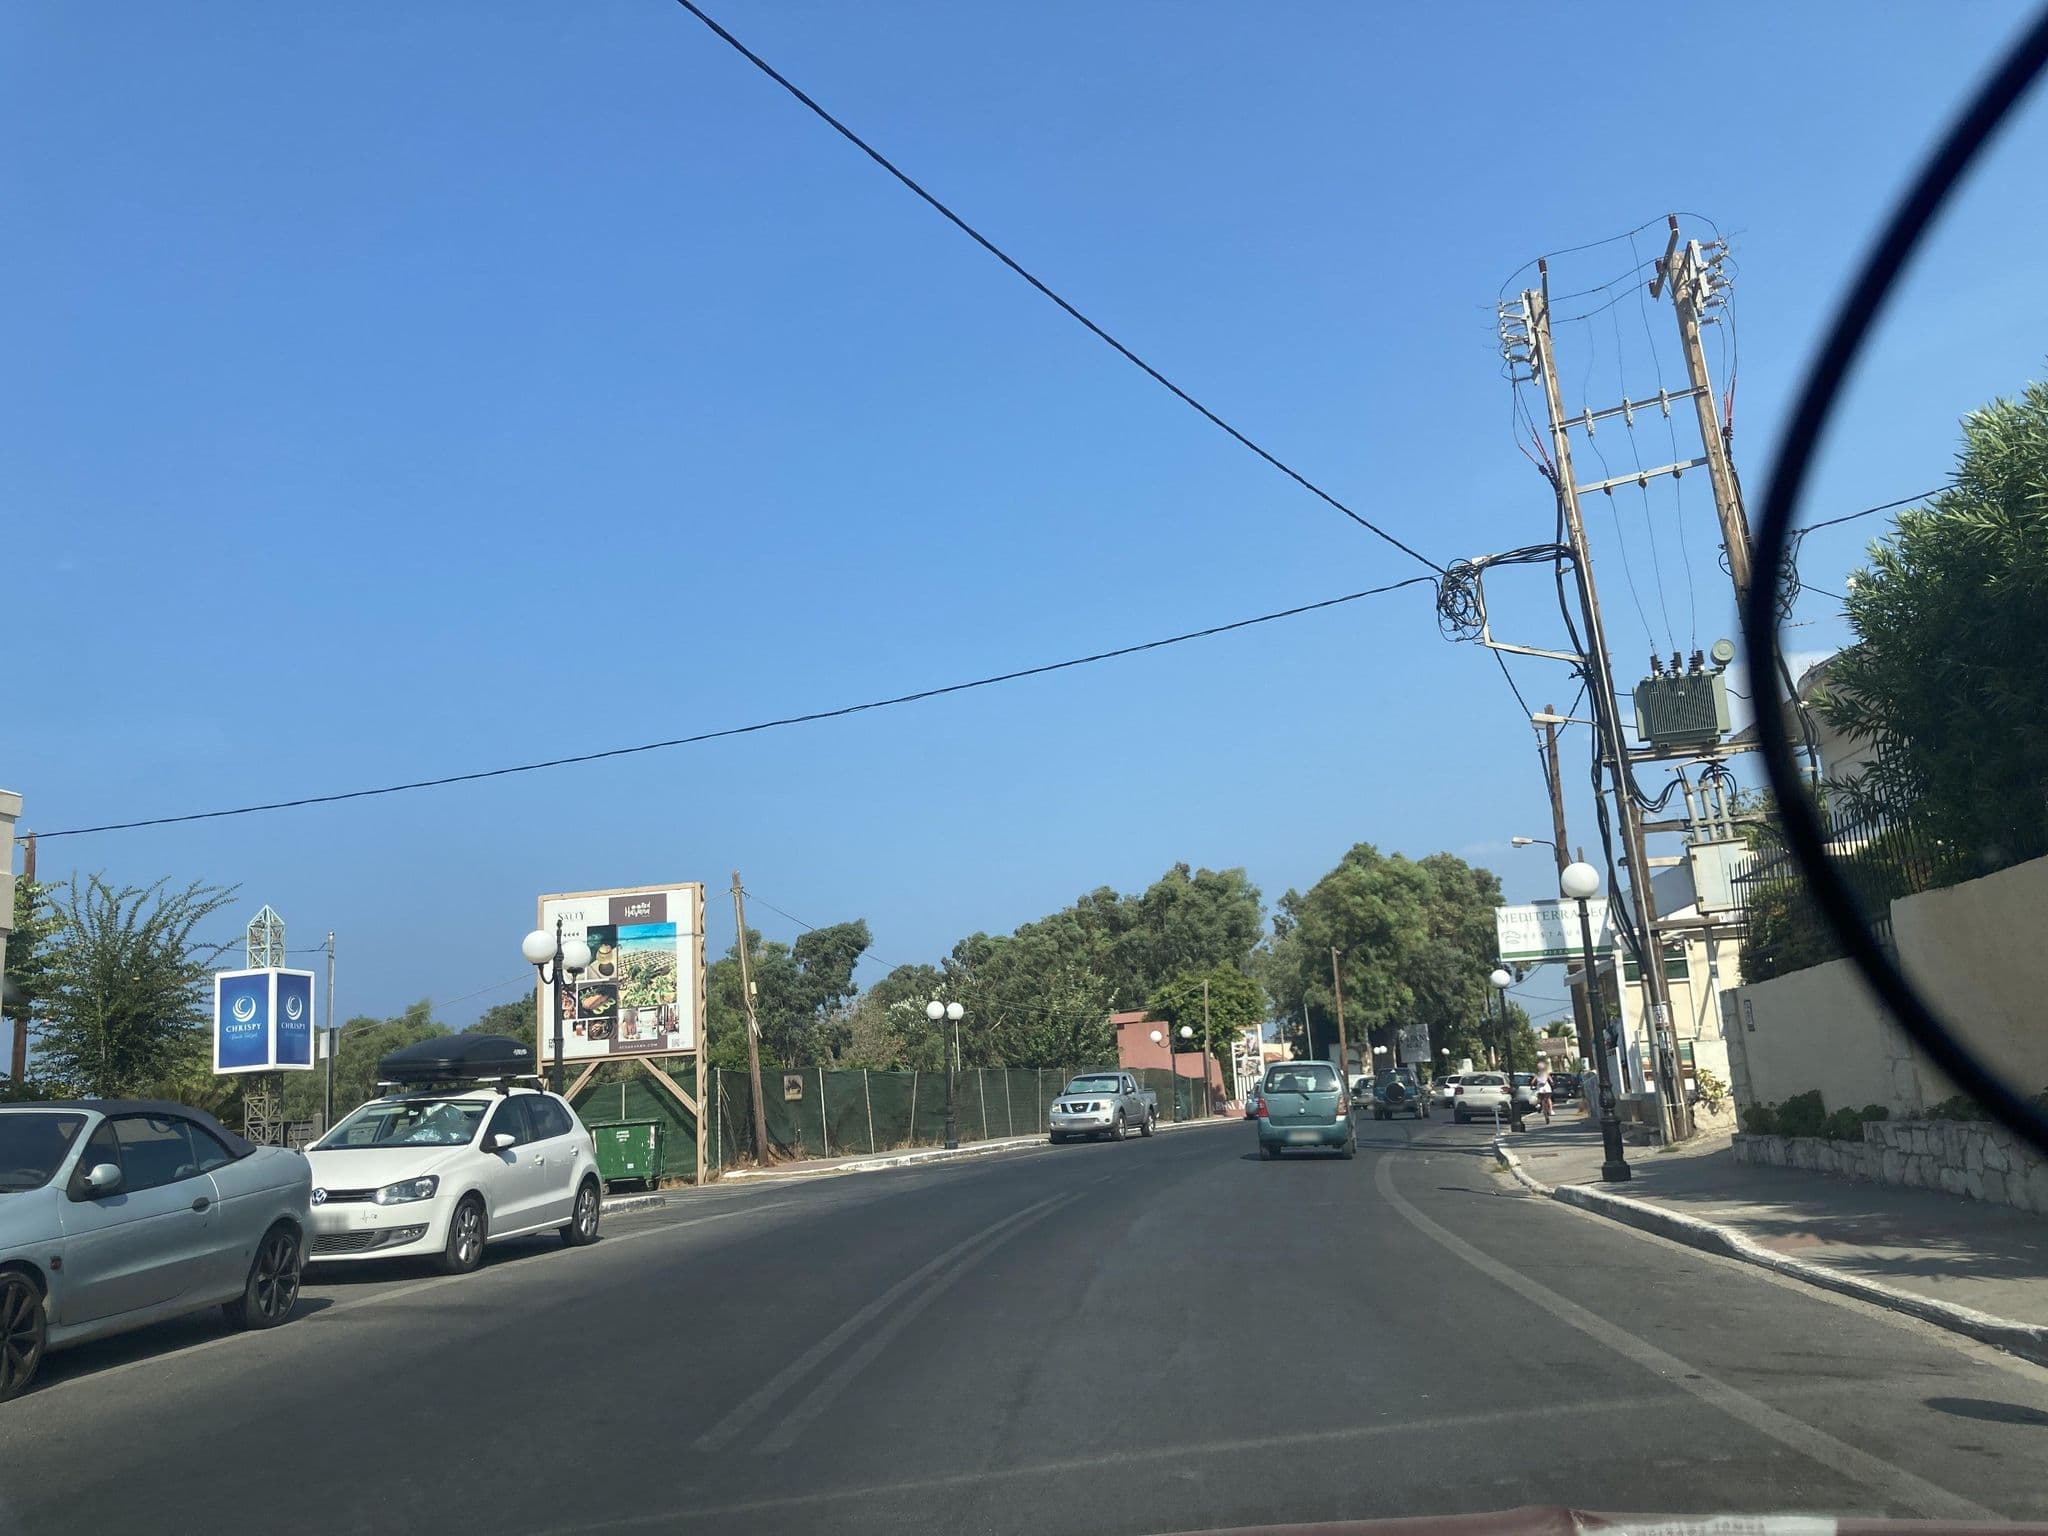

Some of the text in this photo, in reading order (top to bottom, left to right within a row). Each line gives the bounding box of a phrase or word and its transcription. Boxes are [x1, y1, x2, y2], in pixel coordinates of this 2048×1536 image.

[1497, 907, 1608, 923] MEDITERRAEO
[1523, 927, 1609, 939] RESTAURNT
[225, 1022, 262, 1033] CHRISPY
